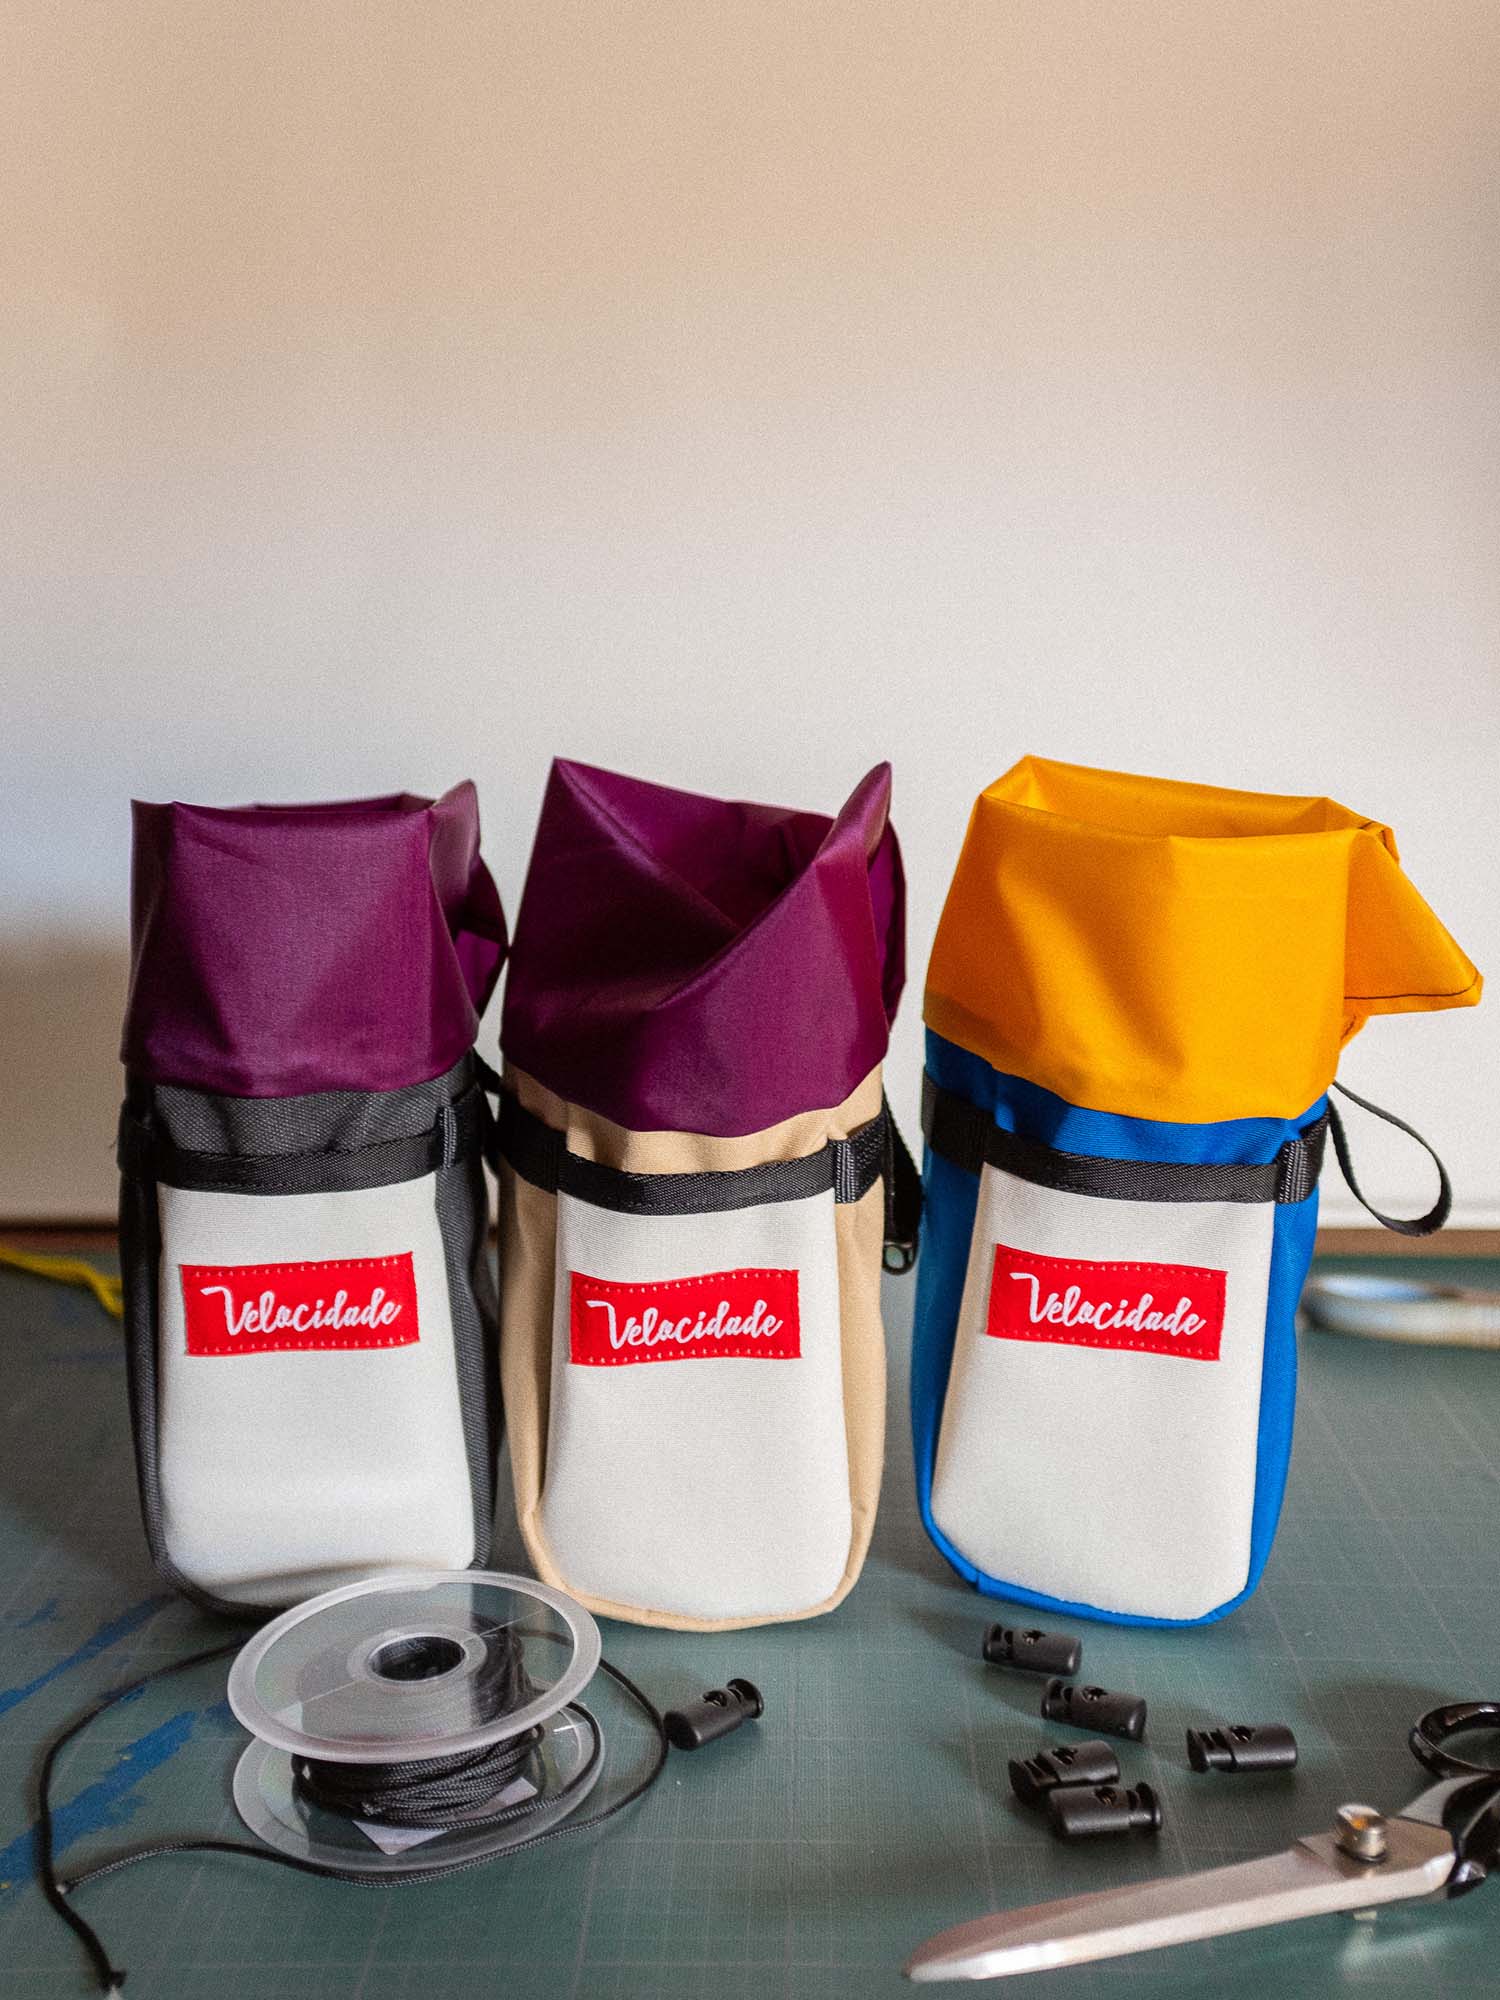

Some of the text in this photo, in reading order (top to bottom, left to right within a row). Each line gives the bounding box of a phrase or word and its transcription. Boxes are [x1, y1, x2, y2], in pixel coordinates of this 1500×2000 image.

[200, 1286, 402, 1336] Velocidade
[586, 1299, 784, 1350] Velocidade
[1009, 1272, 1207, 1337] Velocidade
